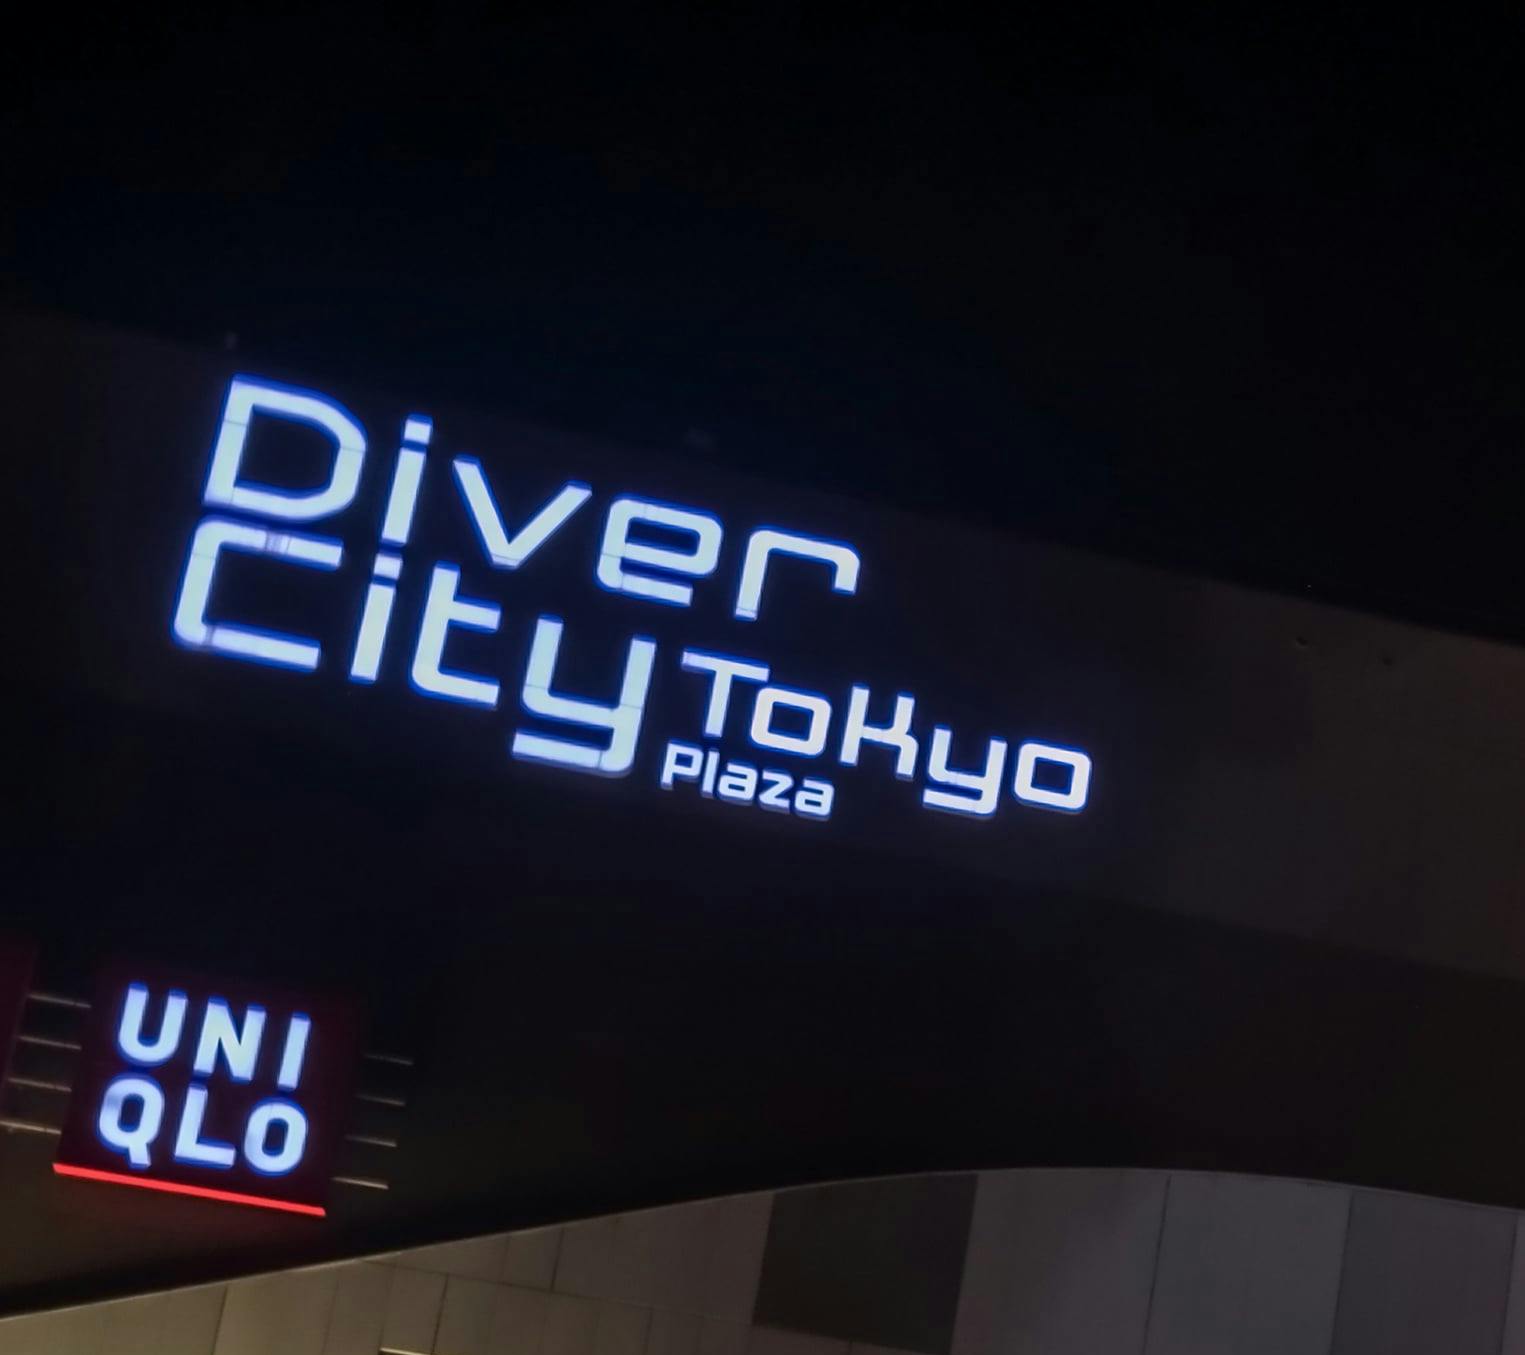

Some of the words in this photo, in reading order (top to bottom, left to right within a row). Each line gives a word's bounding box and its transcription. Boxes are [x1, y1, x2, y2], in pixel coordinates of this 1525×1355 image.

[203, 374, 861, 621] Diver
[172, 517, 657, 777] City
[660, 741, 835, 816] Plaza
[117, 983, 311, 1089] UNI
[98, 1075, 309, 1175] QLO
